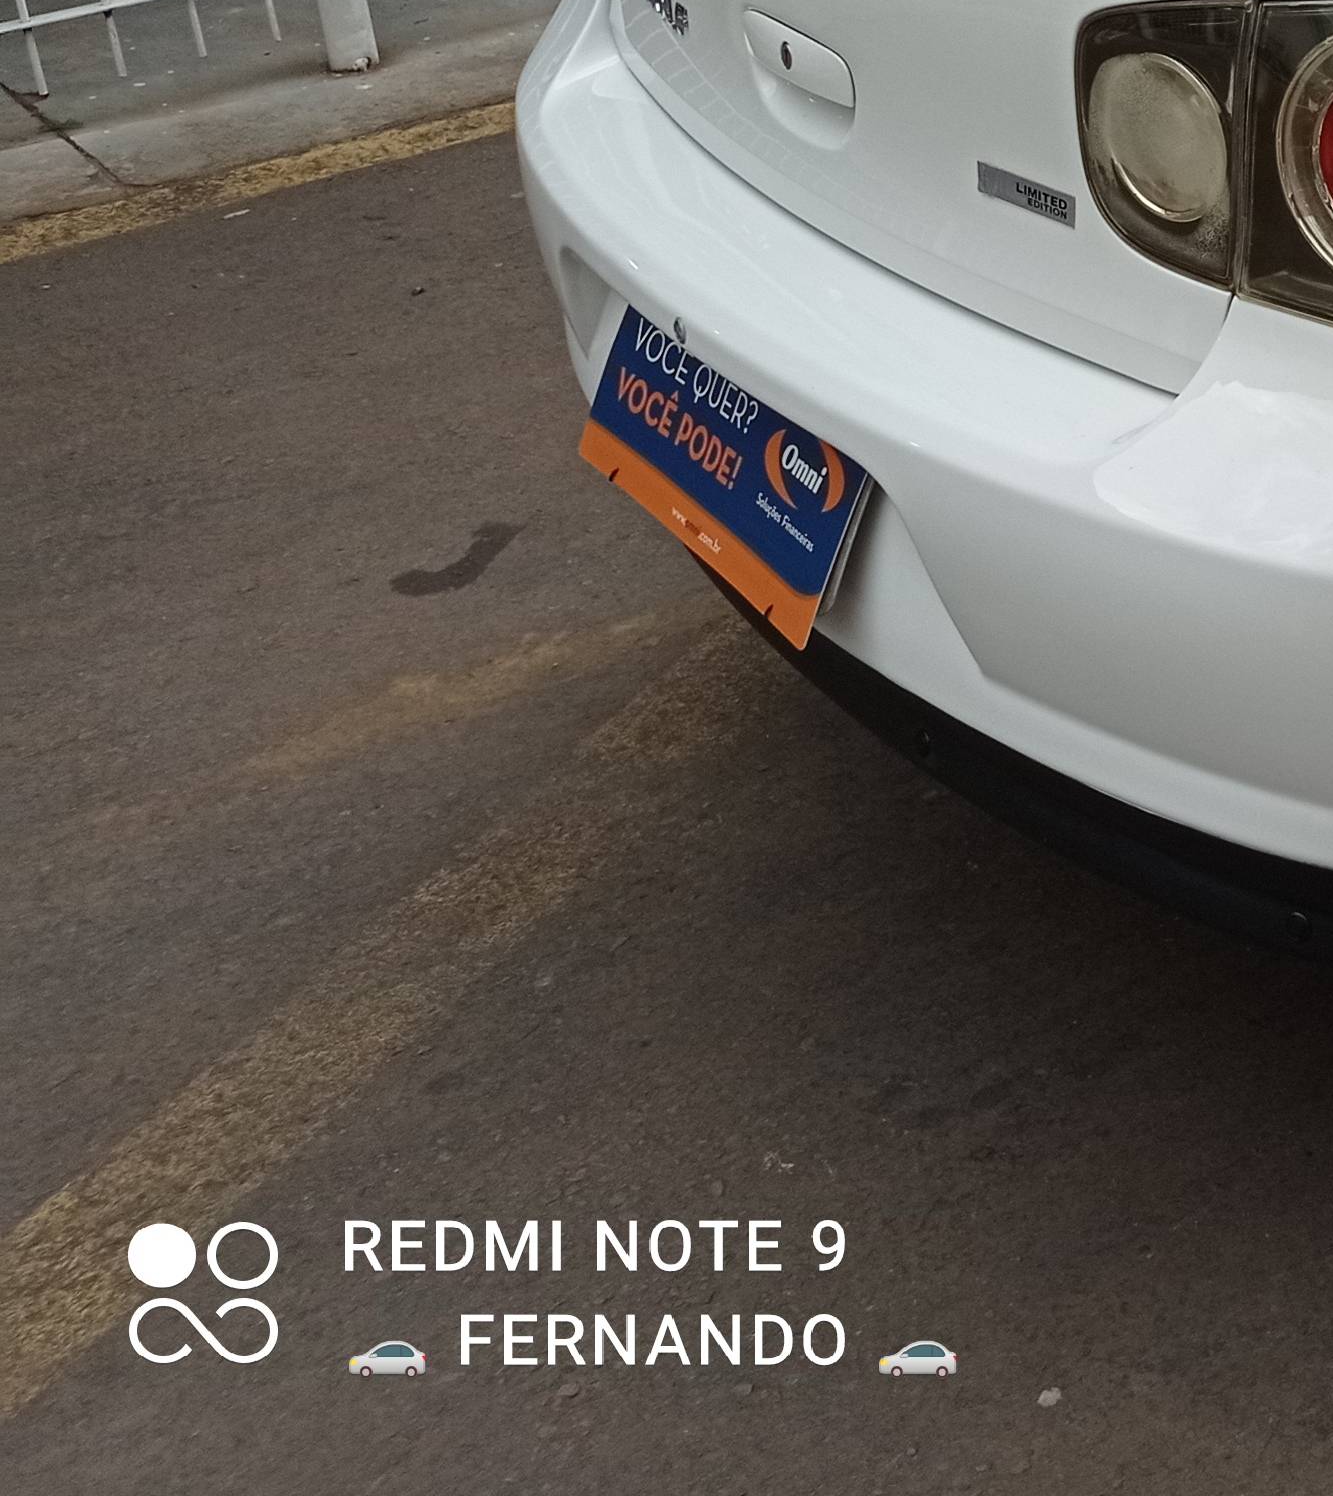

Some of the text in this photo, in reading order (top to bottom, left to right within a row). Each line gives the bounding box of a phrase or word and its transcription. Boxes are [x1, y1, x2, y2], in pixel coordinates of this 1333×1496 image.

[1015, 181, 1069, 211] LIMITED
[1027, 197, 1069, 220] EDITION
[693, 360, 759, 435] QUER?
[618, 366, 743, 490] VOCÊ PODE!
[781, 443, 829, 495] Omni
